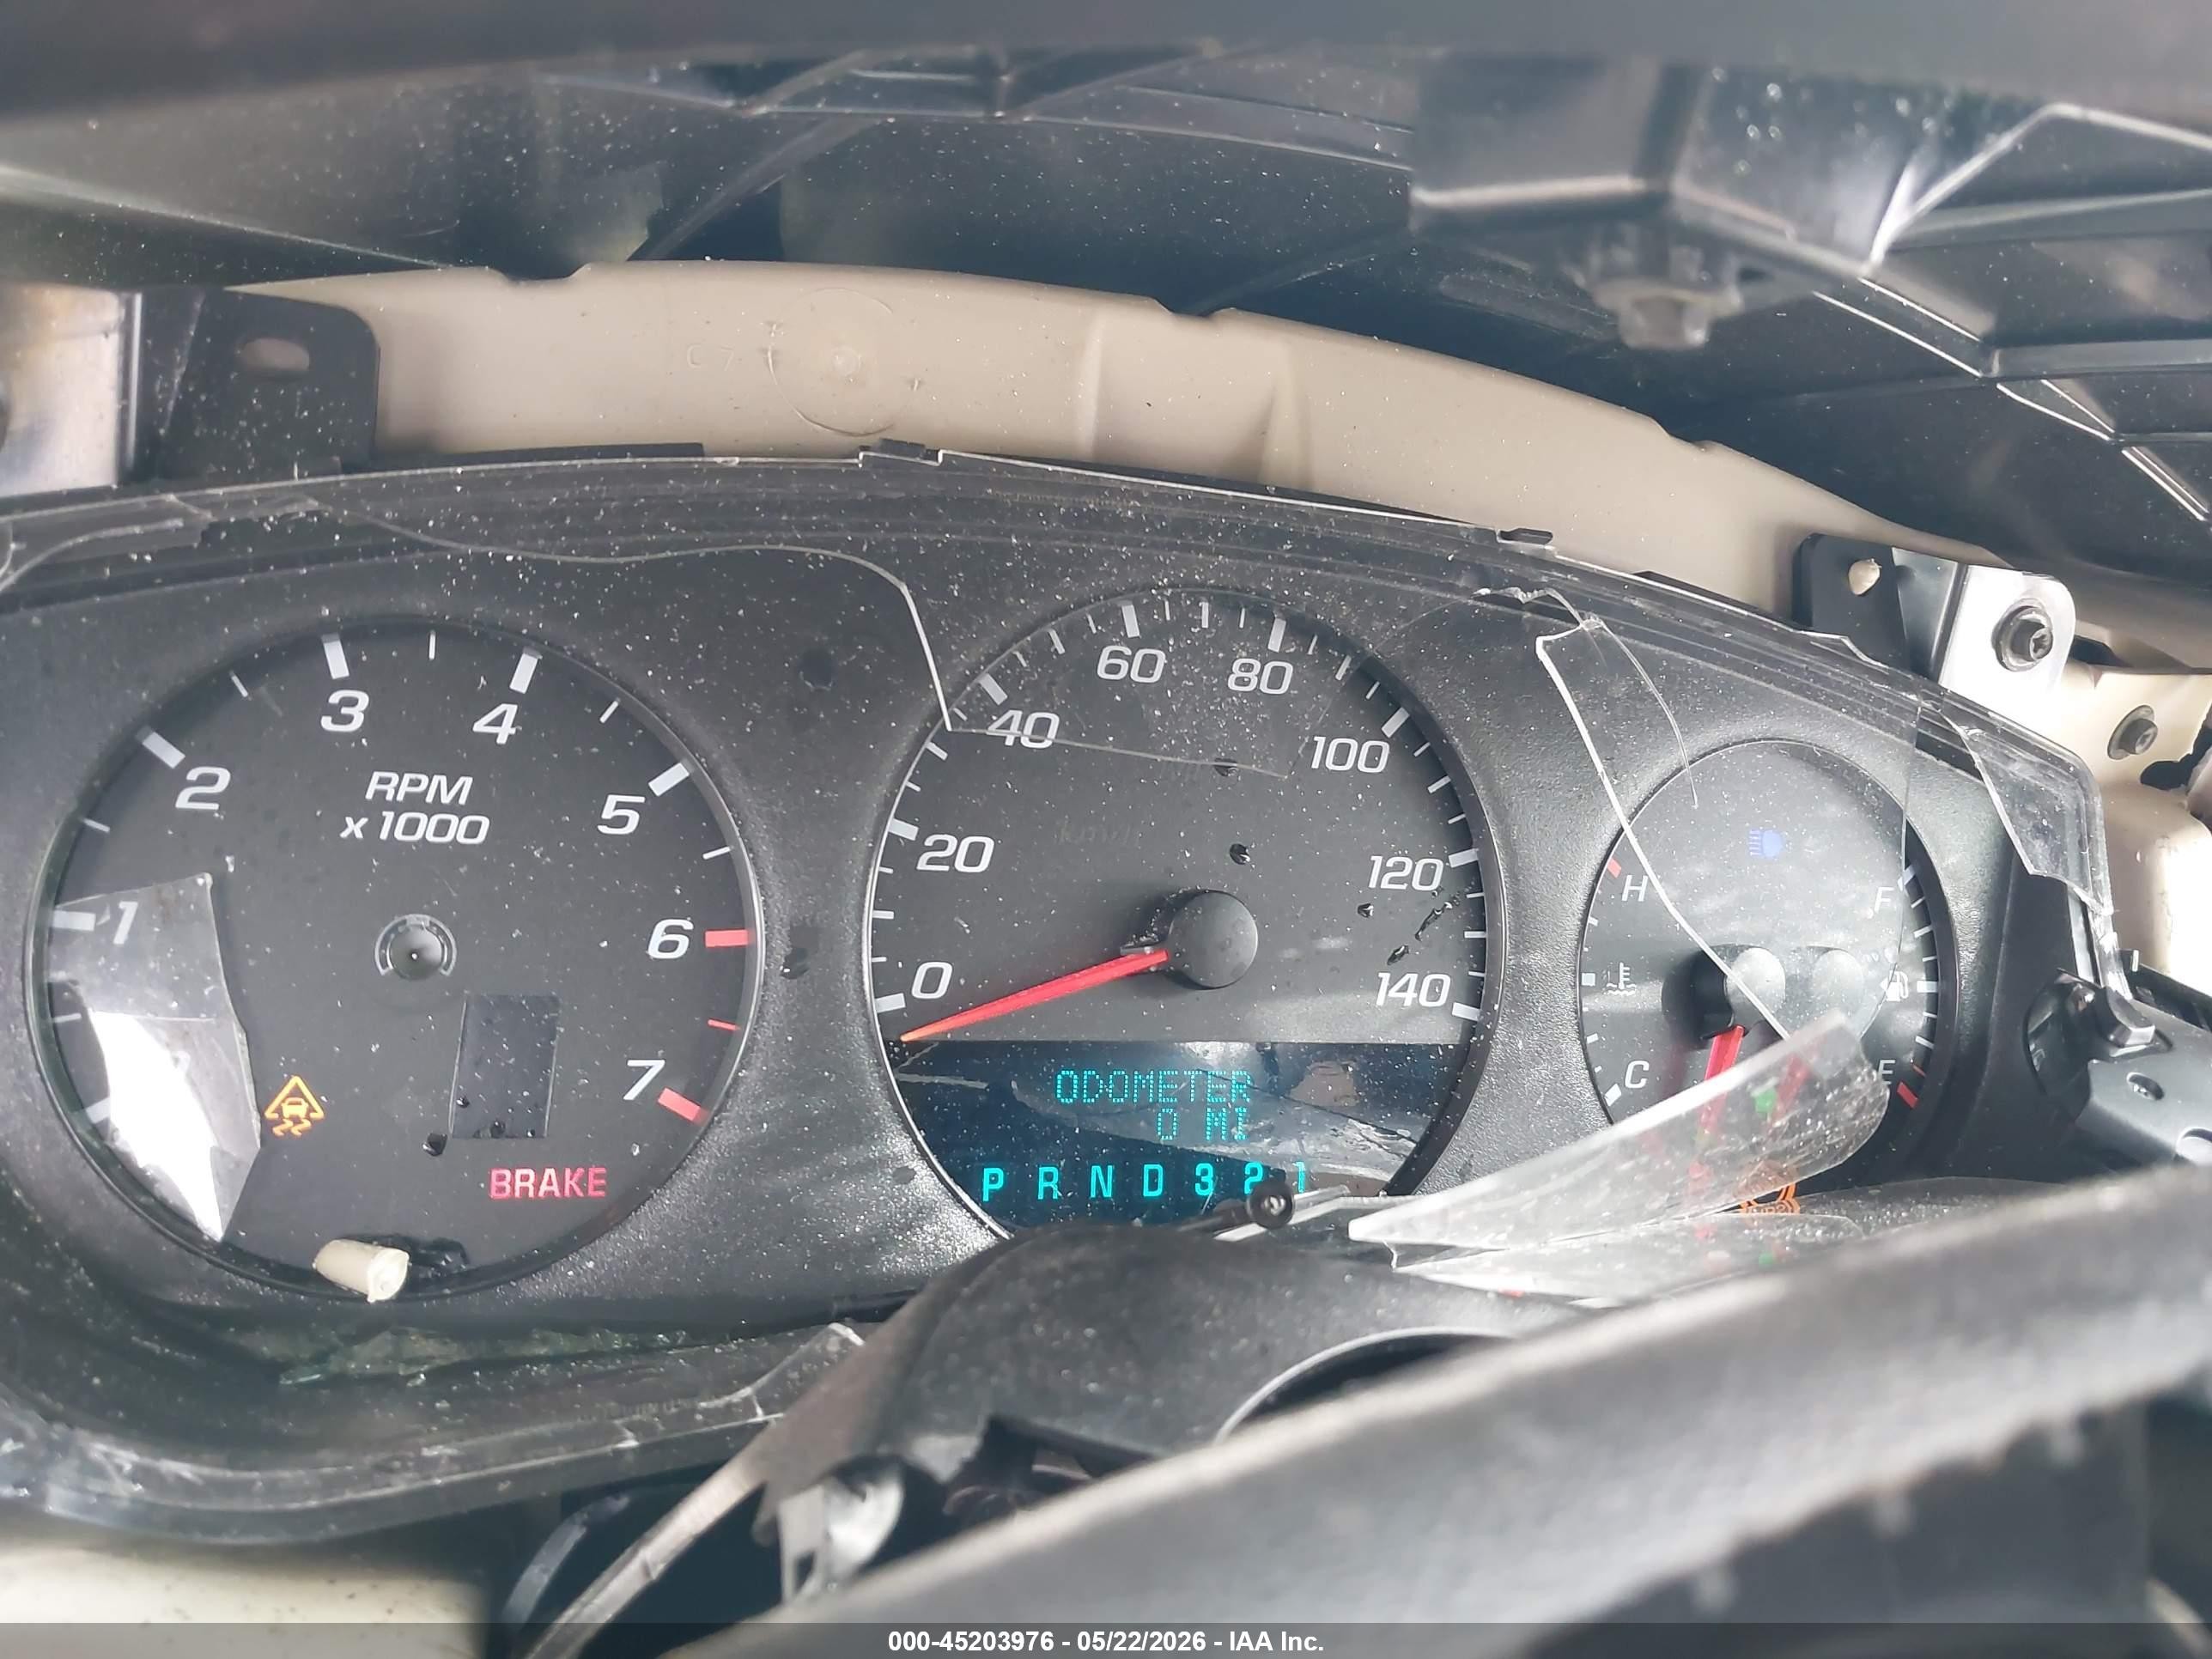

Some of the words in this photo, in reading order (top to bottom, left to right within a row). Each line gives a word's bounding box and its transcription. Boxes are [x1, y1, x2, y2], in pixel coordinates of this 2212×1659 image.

[1097, 646, 1167, 684] 60
[1227, 658, 1293, 695] 80
[321, 690, 369, 732] 3
[472, 703, 519, 745] 4
[986, 709, 1060, 749] 40
[1310, 735, 1390, 774] 100
[174, 766, 231, 811] 2
[365, 770, 473, 805] RPM
[597, 794, 646, 836] 5
[916, 834, 995, 873] 20
[1368, 855, 1443, 891] 120
[1621, 874, 1648, 902] H
[1874, 886, 1894, 913] F
[112, 900, 140, 945] 1
[646, 918, 691, 959] 6
[911, 961, 953, 1000] 0
[1376, 972, 1451, 1010] 140
[624, 1059, 666, 1101] 7
[1054, 1069, 1252, 1104] ODOMETER
[1624, 1060, 1650, 1089] C
[1877, 1059, 1896, 1085] E
[1156, 1107, 1179, 1141] 0
[1205, 1107, 1249, 1141] MI
[489, 1166, 607, 1200] BRAKE
[981, 1167, 1006, 1201] P
[1036, 1165, 1060, 1200] R
[1090, 1164, 1115, 1199] N
[1142, 1164, 1164, 1199] D
[1194, 1162, 1215, 1197] 3
[1243, 1161, 1265, 1196] 2
[1291, 1161, 1306, 1194] 1
